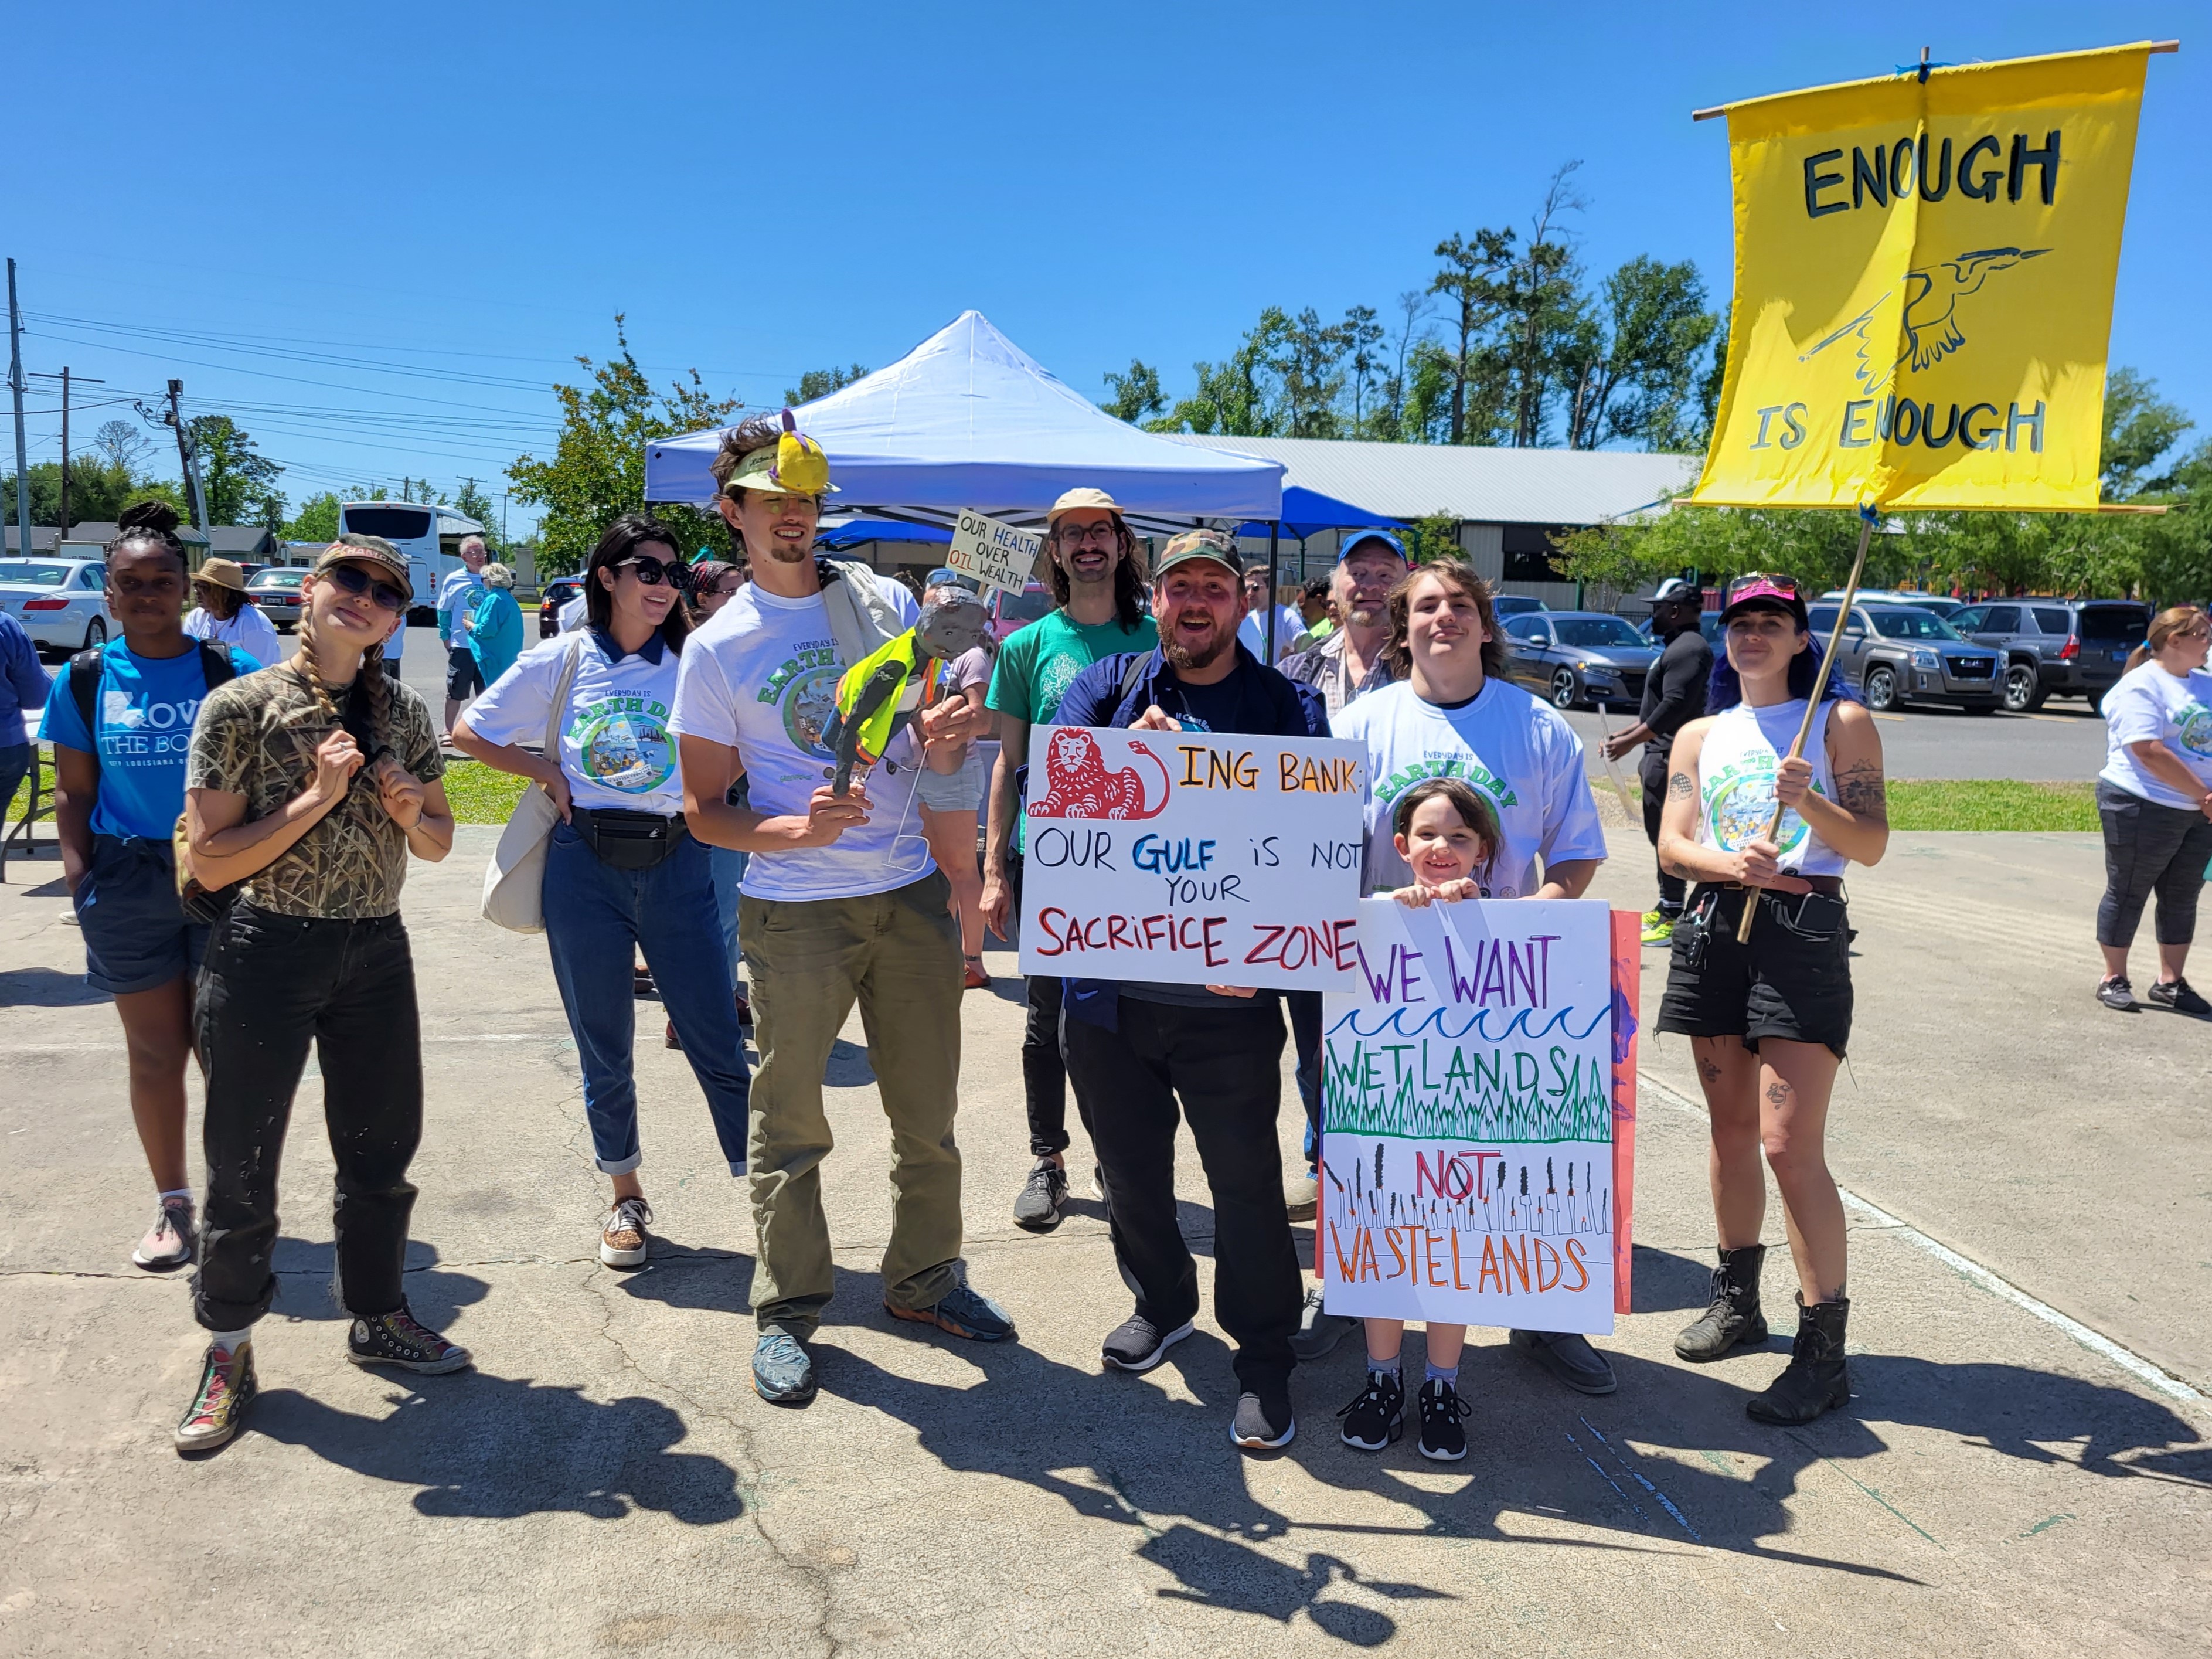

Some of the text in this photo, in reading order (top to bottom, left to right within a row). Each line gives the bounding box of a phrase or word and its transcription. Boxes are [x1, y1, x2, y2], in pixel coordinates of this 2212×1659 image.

[1803, 130, 2061, 219] ENOUGH
[1750, 393, 2047, 453] IS ENOUGH
[961, 516, 1038, 558] OUR HEALTH
[976, 542, 1009, 566] OVER
[949, 550, 1023, 590] OIL WEALTH
[793, 640, 830, 651] EVERYDAY
[757, 648, 836, 706] EARTH
[569, 697, 644, 741] EARTH
[101, 736, 148, 754] THE
[1423, 750, 1474, 761] EVERYDAY IS
[1178, 746, 1363, 794] ING BANK:
[1373, 760, 1519, 808] EARTH DAY
[1035, 827, 1117, 872] OUR
[1132, 832, 1217, 874] GULF
[1311, 839, 1363, 870] NOT
[1164, 873, 1250, 906] YOUR
[1244, 919, 1357, 971] ZONE
[1357, 934, 1562, 1009] WE WANT
[1325, 1038, 1567, 1097] WETLANDS
[1415, 1149, 1502, 1201] NOT
[1328, 1216, 1590, 1296] WASTELANDS
